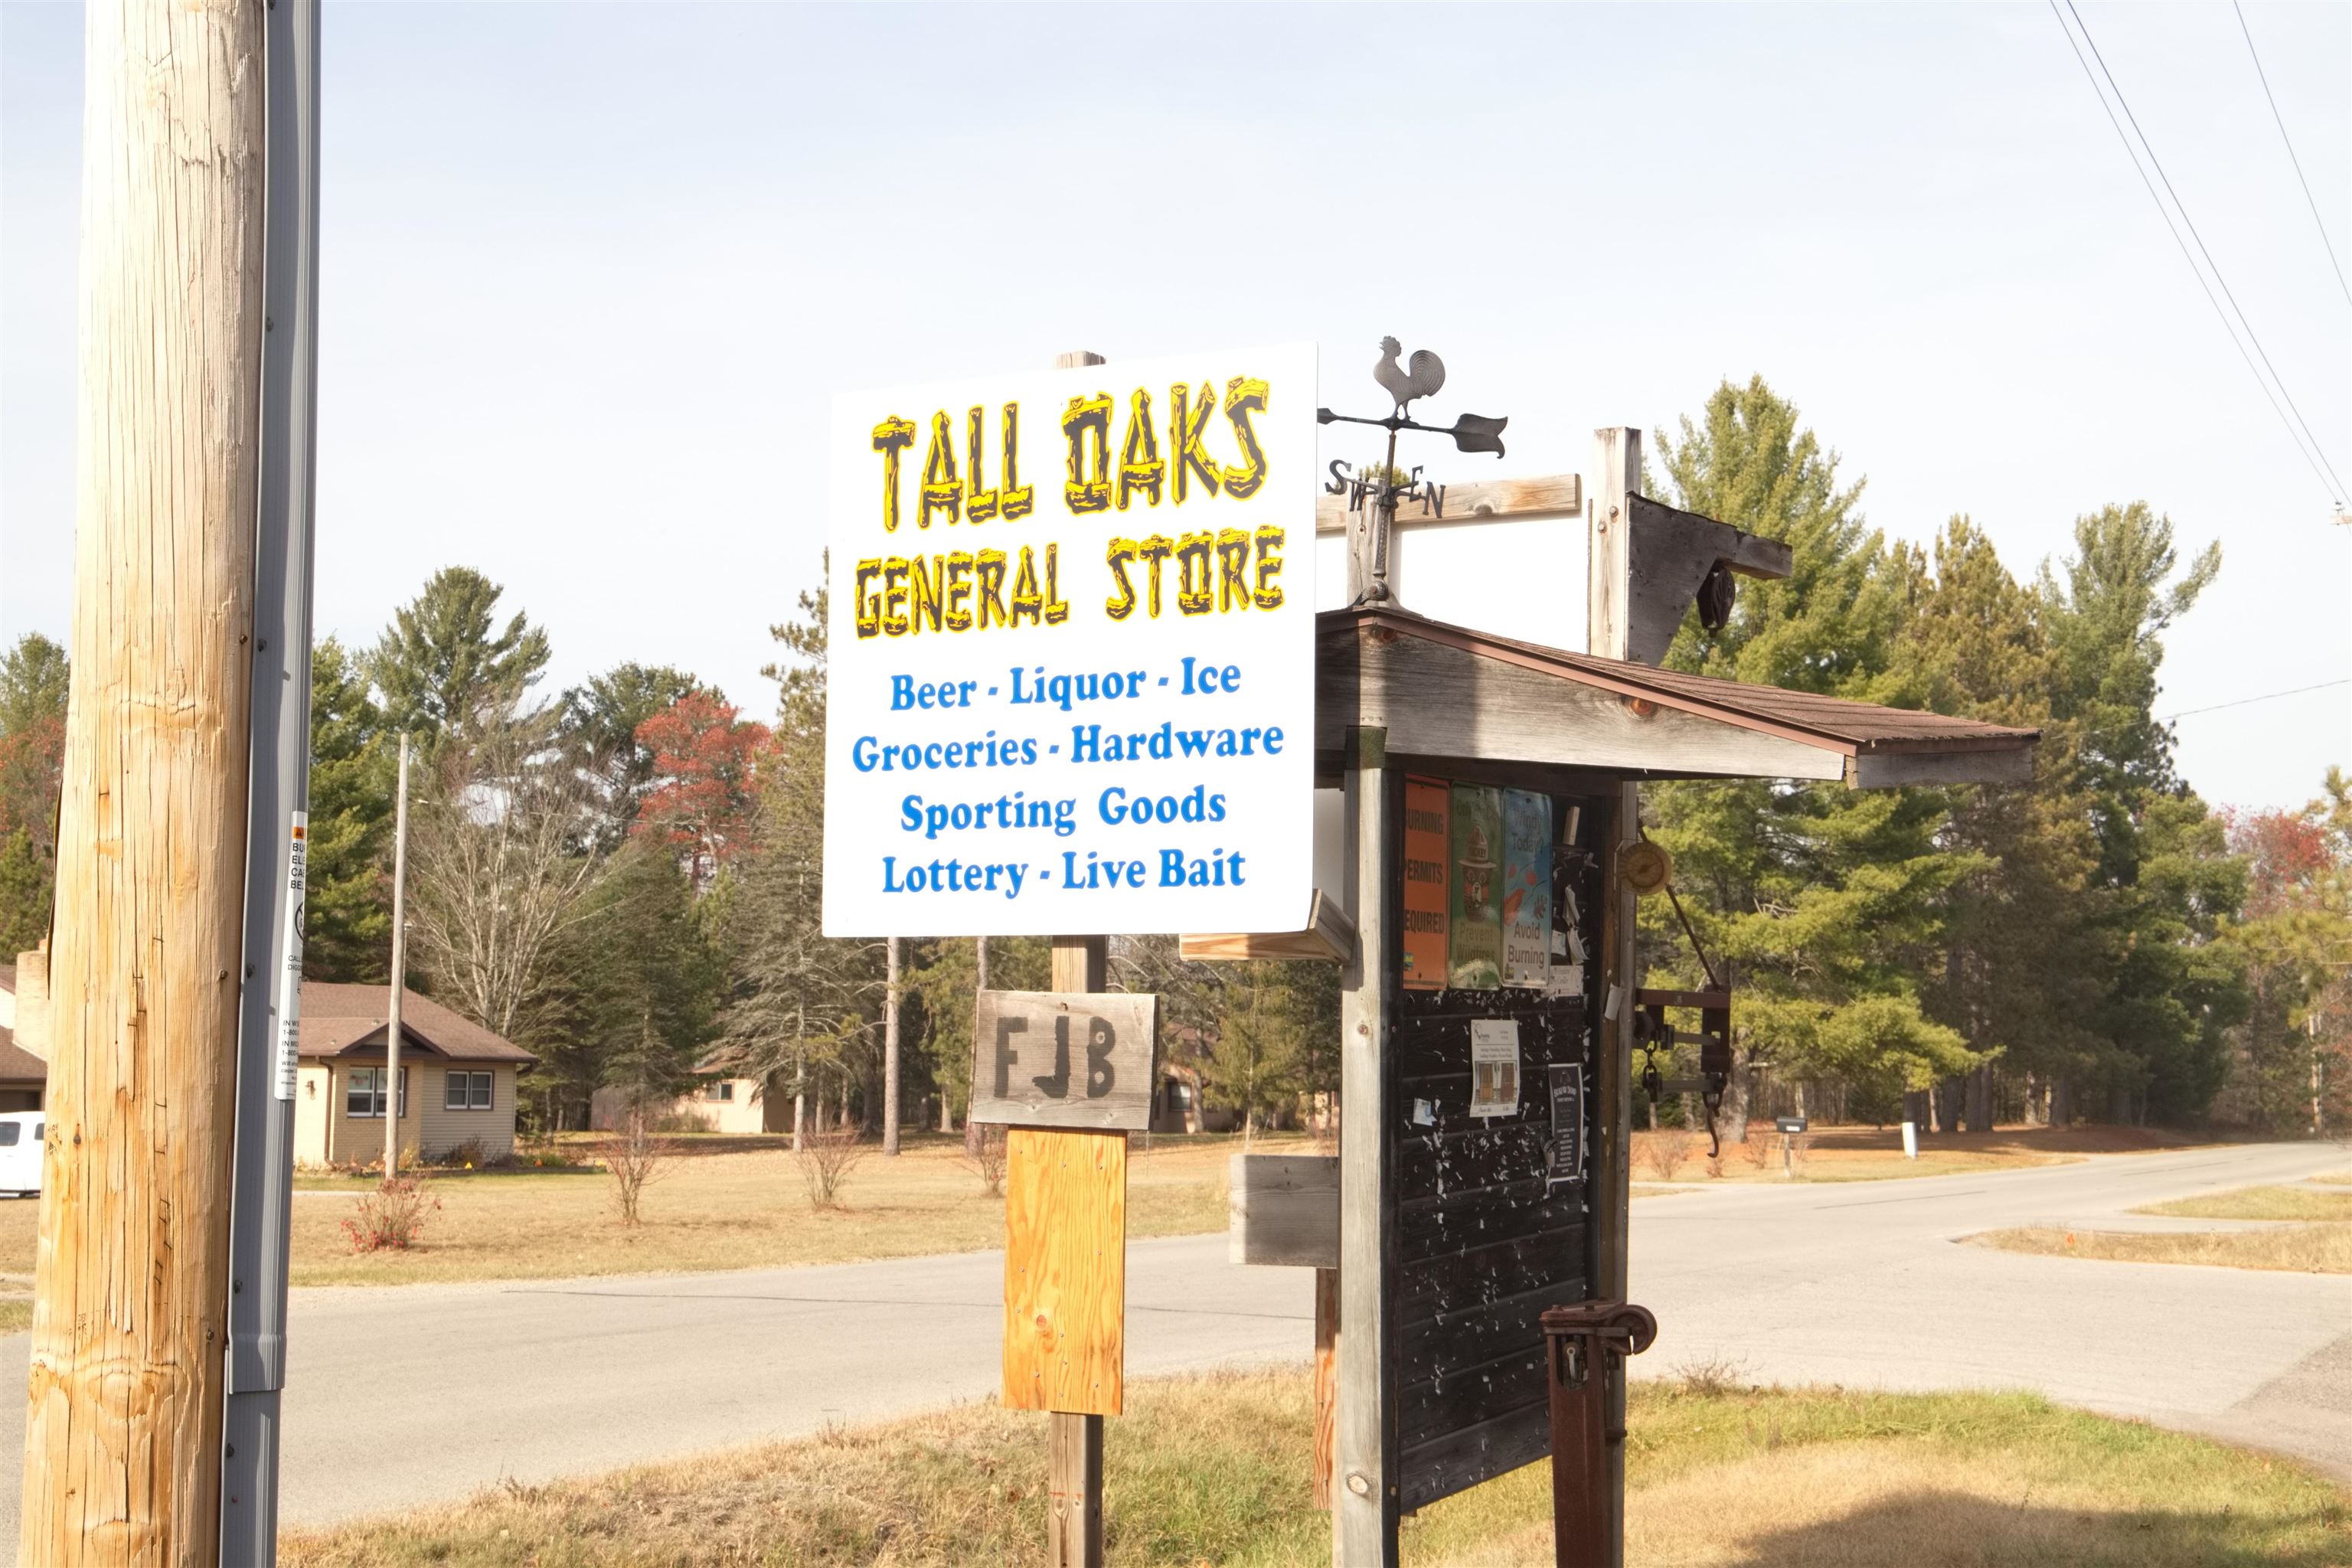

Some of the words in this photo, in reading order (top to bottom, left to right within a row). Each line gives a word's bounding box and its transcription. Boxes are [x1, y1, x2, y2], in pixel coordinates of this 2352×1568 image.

[871, 400, 1035, 534] TALL
[1060, 374, 1270, 517] OAKS
[1325, 459, 1352, 495] S
[1422, 481, 1446, 518] N
[854, 541, 1070, 641] GENERAL
[1105, 524, 1285, 622] STORE
[891, 675, 977, 710] Beer
[1011, 666, 1146, 711] Liquor
[1181, 657, 1241, 695] Ice
[853, 730, 1037, 772] Groceries
[1071, 722, 1284, 763] Hardware
[901, 791, 1076, 840] Sporting
[1099, 784, 1225, 825] Goods
[1405, 808, 1444, 835] URNING
[1511, 808, 1542, 835] Windy
[1511, 832, 1544, 854] Today?
[883, 857, 1028, 900] Lottery
[1063, 851, 1146, 889] Live
[1158, 848, 1245, 887] Bait
[1403, 909, 1445, 934] EQUIRED
[1459, 923, 1494, 942] Prevent
[1514, 922, 1540, 941] Avoid
[1456, 942, 1495, 962] Wildfires
[1508, 945, 1545, 970] Burning
[994, 1016, 1116, 1099] FJB
